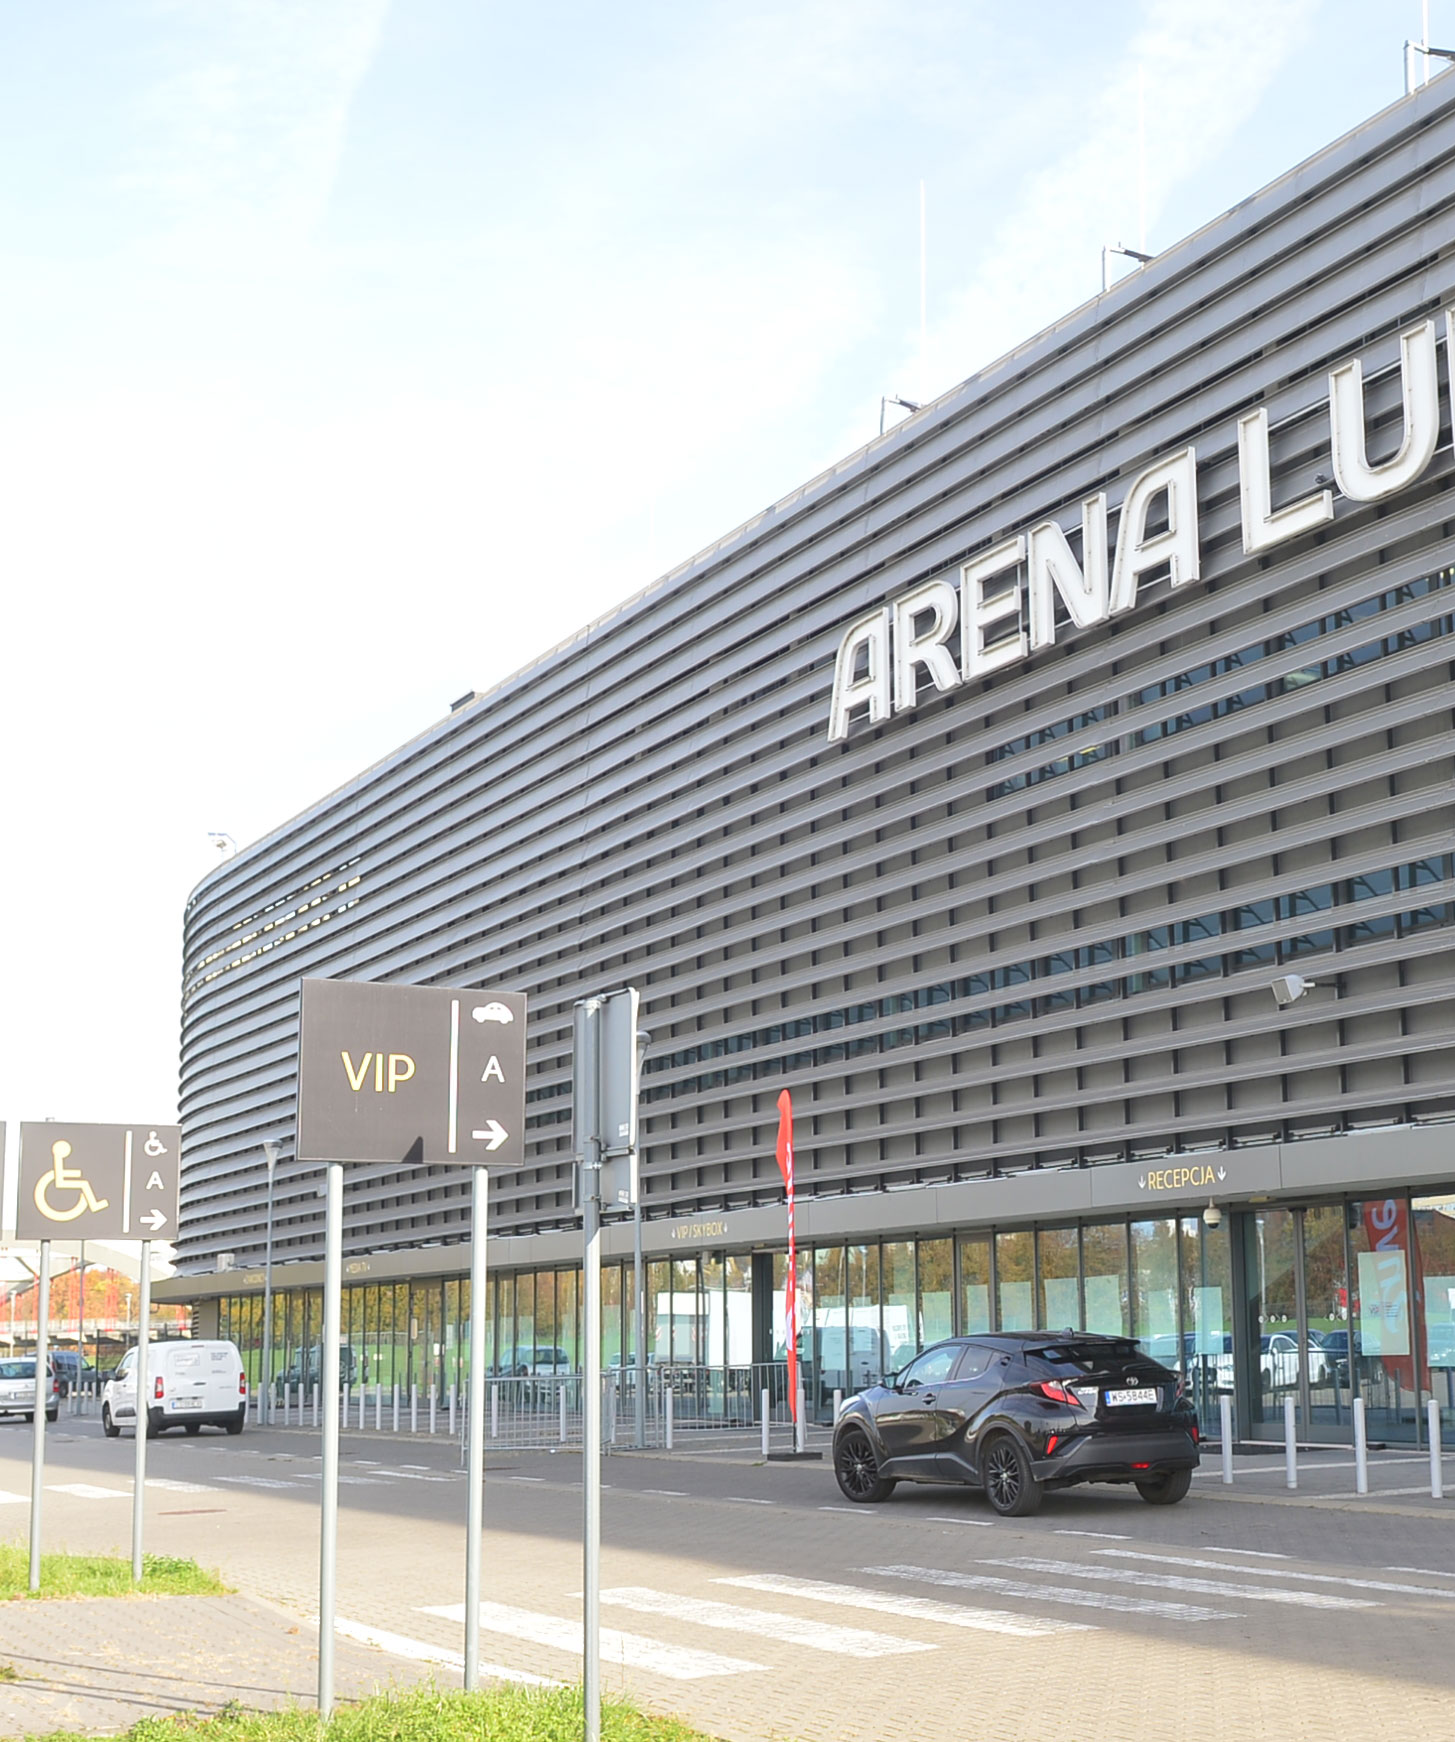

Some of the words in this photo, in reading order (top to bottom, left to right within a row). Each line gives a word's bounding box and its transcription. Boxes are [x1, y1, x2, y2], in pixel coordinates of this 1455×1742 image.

[828, 445, 1200, 742] ARENA
[341, 1051, 416, 1093] VIP
[481, 1055, 505, 1083] A
[146, 1171, 164, 1190] A
[1148, 1165, 1216, 1190] RECEPCJA
[676, 1224, 688, 1239] VIP
[693, 1221, 723, 1239] SKYBOX
